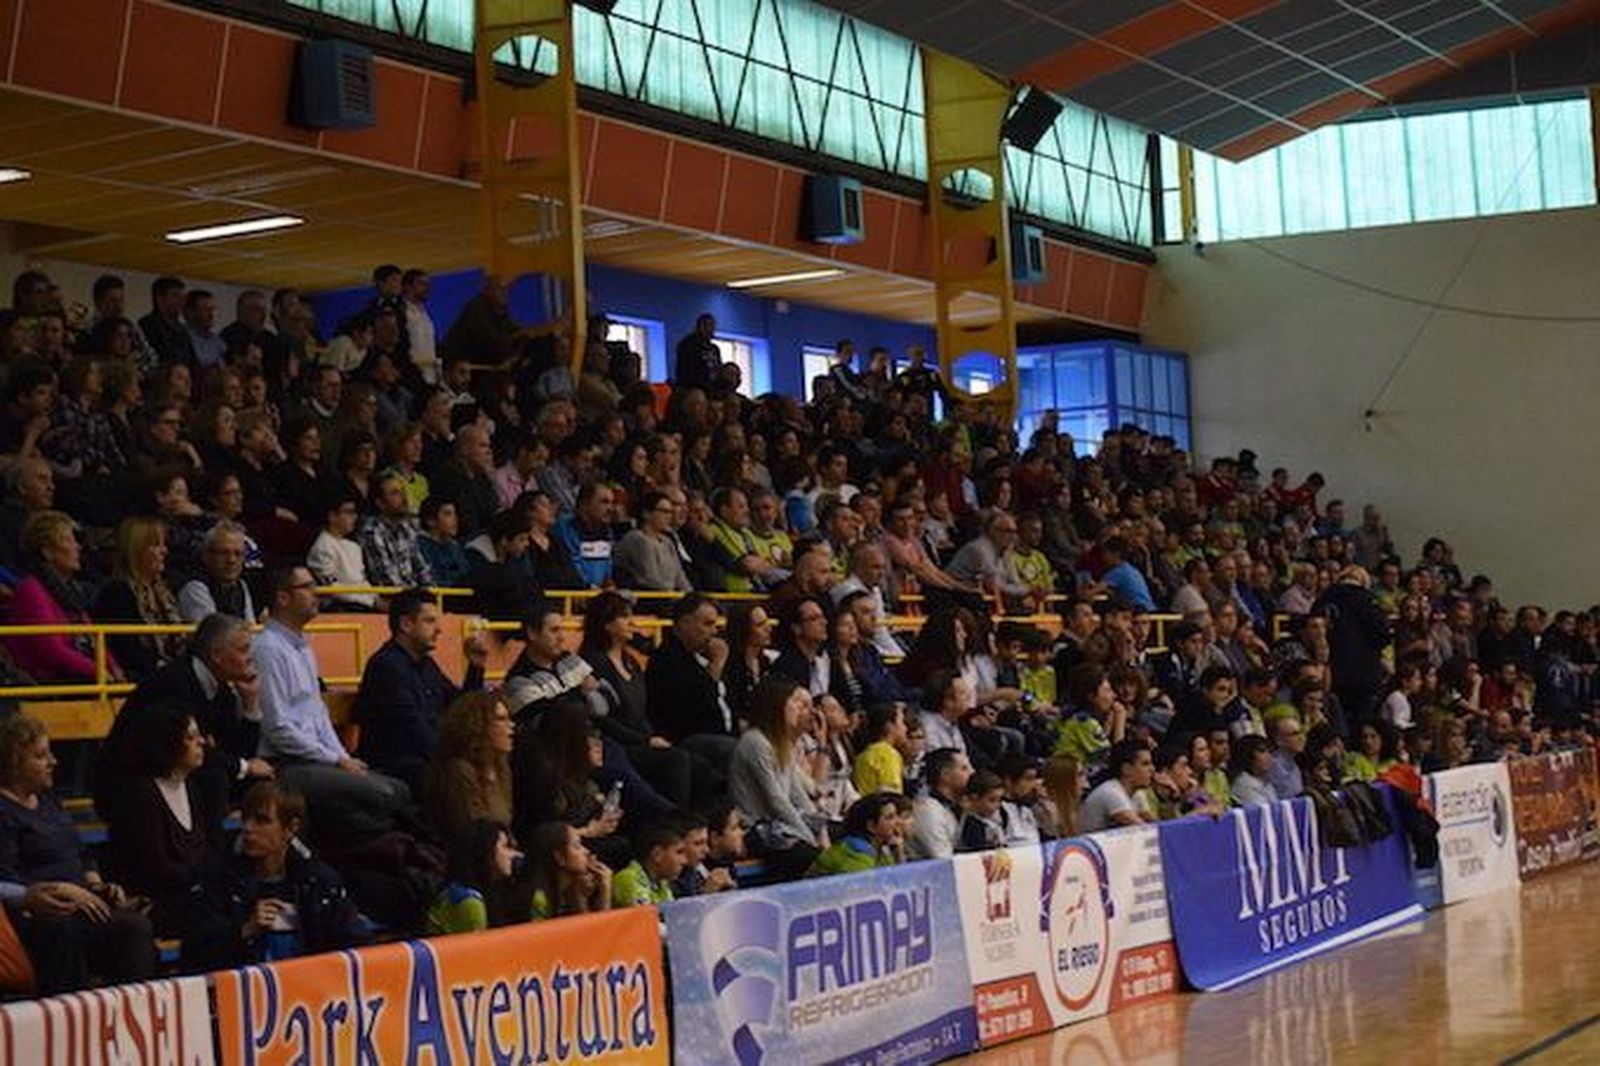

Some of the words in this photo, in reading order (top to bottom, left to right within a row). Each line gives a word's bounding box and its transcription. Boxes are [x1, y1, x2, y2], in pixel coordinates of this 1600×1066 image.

[787, 886, 932, 1002] FRIMAY
[1058, 949, 1069, 972] EL
[1258, 890, 1348, 953] SEGUROS
[239, 950, 384, 1066] Park
[403, 939, 656, 1066] Aventura
